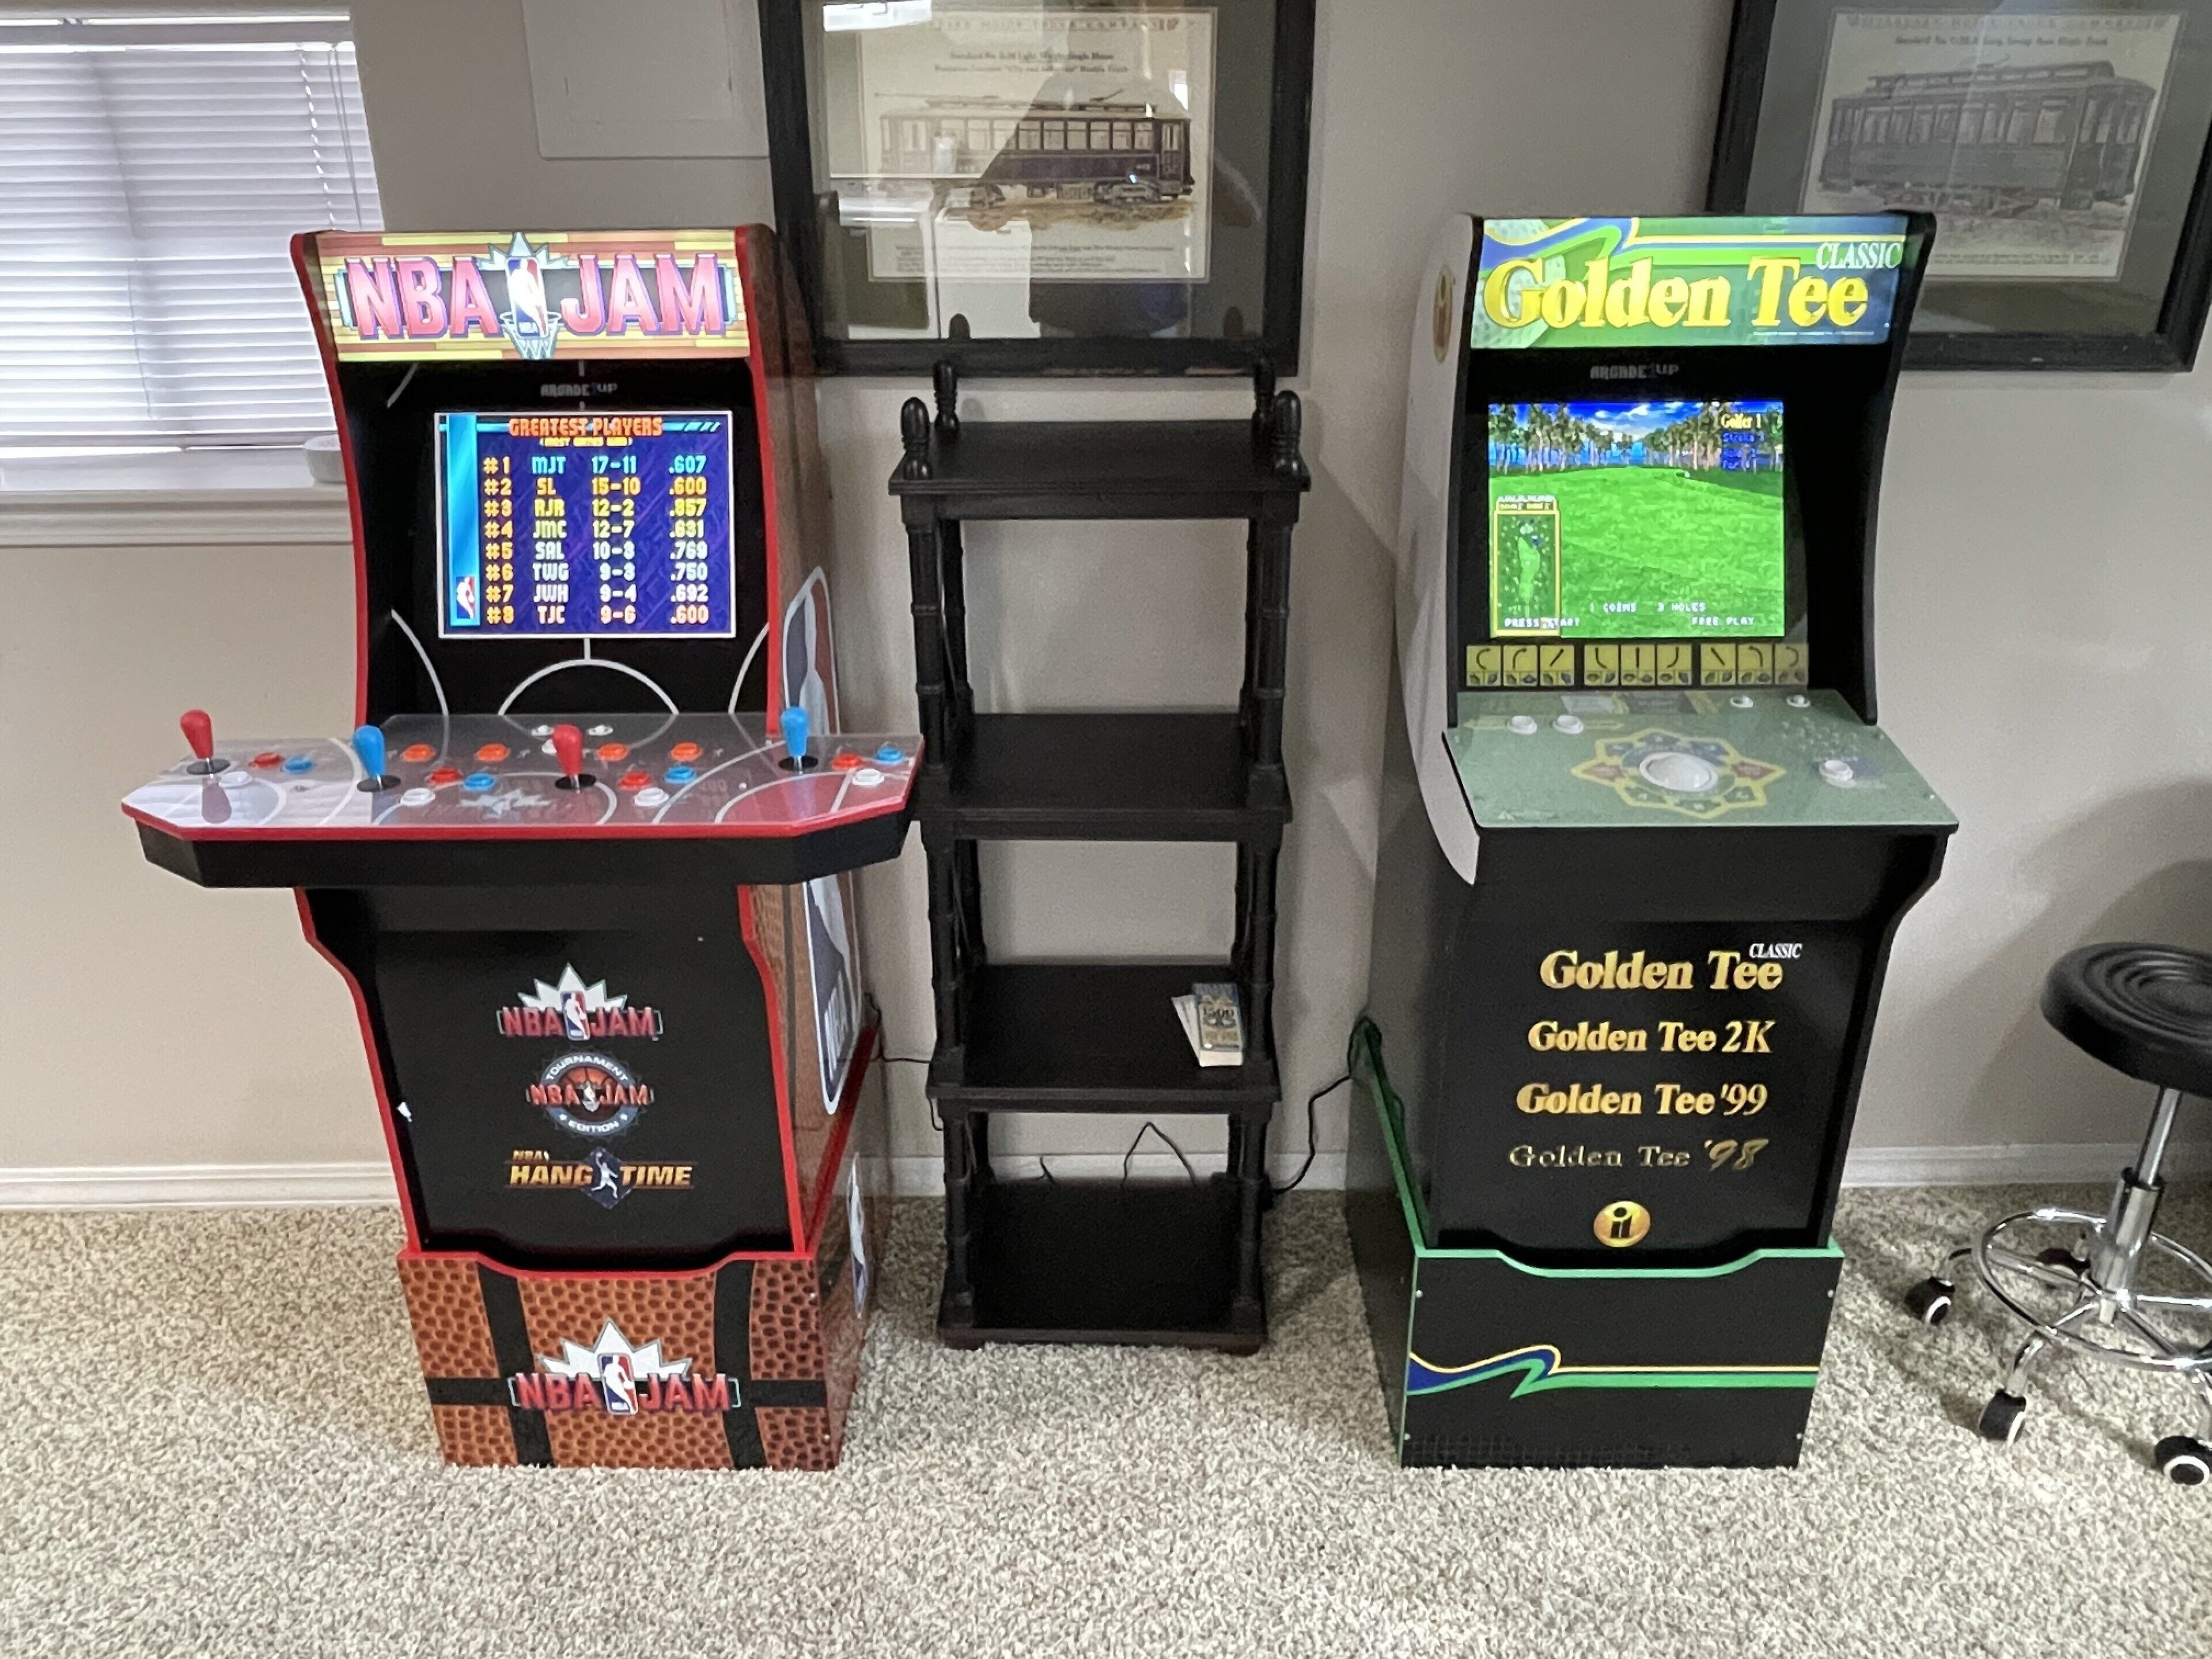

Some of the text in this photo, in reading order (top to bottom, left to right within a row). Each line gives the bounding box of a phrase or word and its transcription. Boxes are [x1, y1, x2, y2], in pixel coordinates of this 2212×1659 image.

[1815, 241, 1902, 271] CLASSIC
[344, 253, 728, 340] NBA JAM
[1482, 256, 1870, 330] Golden Tee
[1590, 363, 1679, 380] ARCADEUP
[540, 382, 618, 397] ARCADEUP
[509, 418, 663, 437] GREATEST PLAYERS
[532, 456, 566, 475] MJT
[592, 455, 637, 474] 17-11
[669, 454, 707, 474] .607
[536, 477, 556, 495] SL
[592, 476, 641, 495] 15-10
[669, 476, 707, 495] .600
[592, 498, 634, 517] 12-2
[532, 520, 567, 539] JMC
[592, 519, 634, 539] 12-7
[535, 541, 565, 560] SAL
[593, 541, 635, 560] 10-3
[669, 540, 708, 560] .769
[532, 562, 569, 582] TWG
[671, 562, 708, 581] .750
[533, 584, 569, 603] JWH
[537, 605, 565, 624] TJC
[671, 604, 709, 624] .600
[1671, 602, 1706, 612] HOLES
[1504, 618, 1540, 628] PRESS
[1691, 617, 1755, 626] FREE PLAY
[1749, 943, 1802, 959] CLASSIC
[1540, 950, 1783, 990] Golden Tee
[502, 1006, 655, 1037] NBA JAM
[1528, 1021, 1775, 1053] Golden Tee 2K
[546, 1055, 628, 1081] TOURNAMENT
[530, 1084, 647, 1105] NBA JAM
[1516, 1083, 1768, 1116] Golden Tee '99
[567, 1120, 619, 1132] EDITION
[1509, 1145, 1623, 1168] Golden
[1638, 1146, 1690, 1168] Tee
[510, 1165, 692, 1185] HANG TIME
[514, 1373, 730, 1412] NBA JAM
